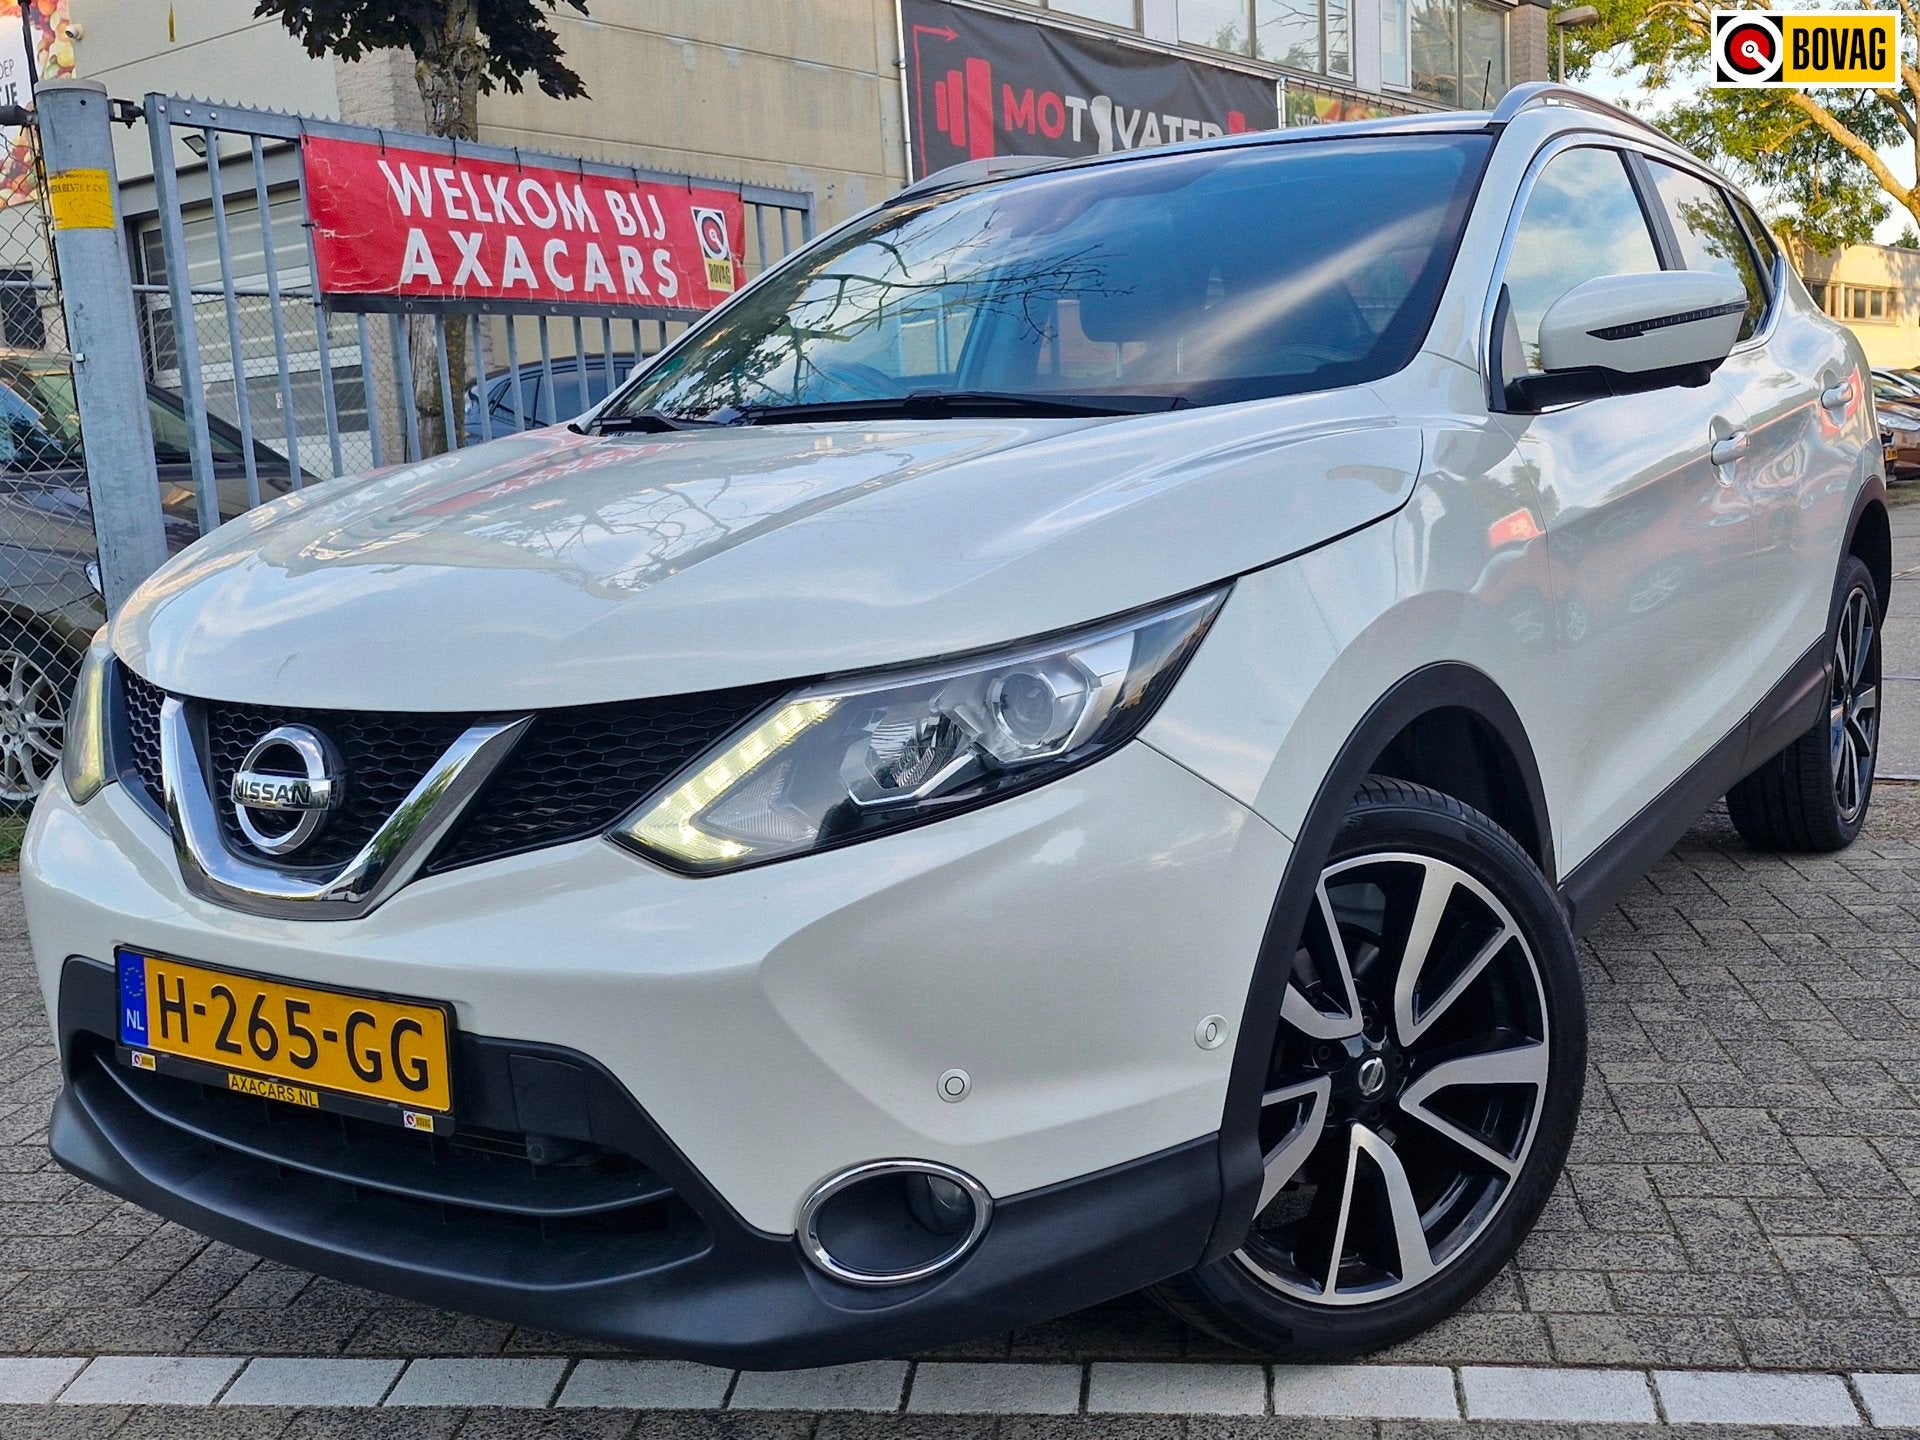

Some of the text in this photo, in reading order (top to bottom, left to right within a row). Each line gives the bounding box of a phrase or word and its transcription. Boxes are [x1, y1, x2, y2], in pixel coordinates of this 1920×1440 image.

[377, 159, 667, 241] WELKOM BIJ
[401, 228, 679, 299] AXACARS
[708, 263, 732, 285] BOVAG
[233, 779, 311, 805] NISSAN
[126, 1007, 145, 1032] NL
[157, 972, 431, 1092] H-265-GG
[231, 1075, 318, 1107] AXACARS.NL
